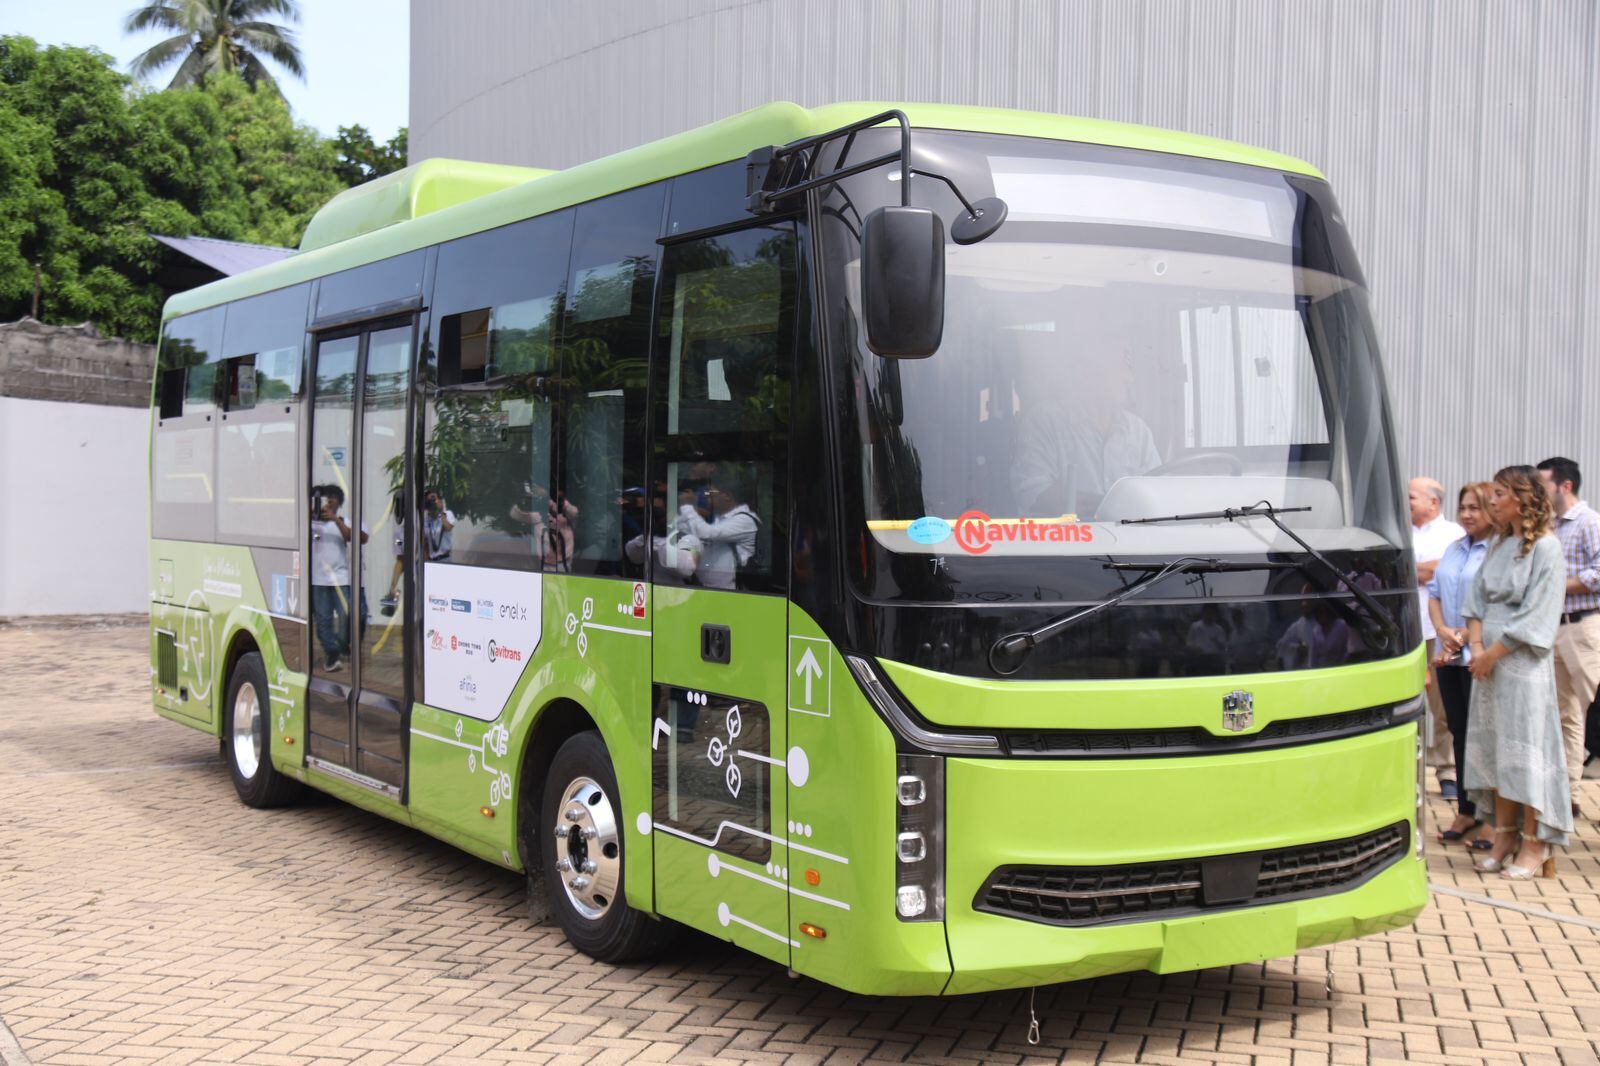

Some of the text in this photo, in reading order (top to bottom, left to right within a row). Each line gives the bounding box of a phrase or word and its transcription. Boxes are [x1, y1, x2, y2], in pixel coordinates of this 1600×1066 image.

[954, 510, 1093, 554] Navitrans
[500, 603, 518, 620] enel
[521, 607, 527, 621] x
[487, 639, 521, 663] Navitrans
